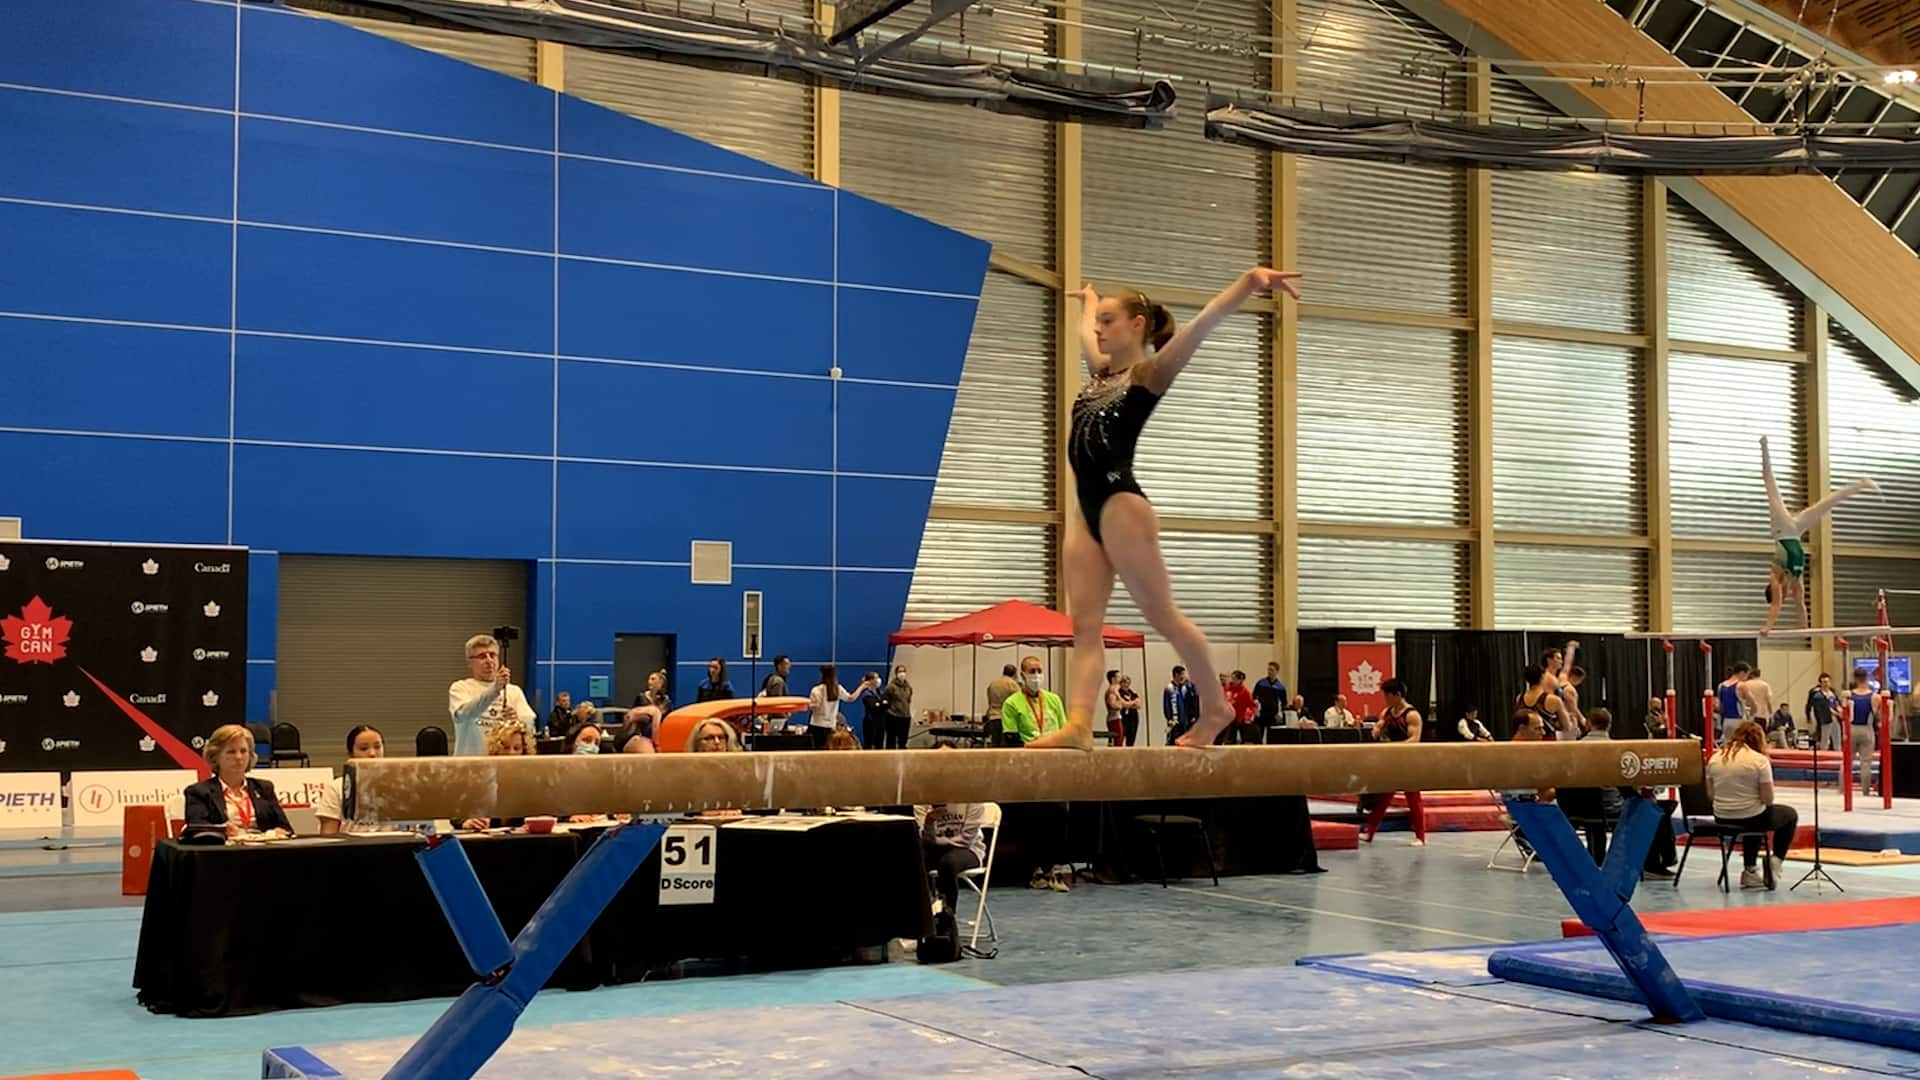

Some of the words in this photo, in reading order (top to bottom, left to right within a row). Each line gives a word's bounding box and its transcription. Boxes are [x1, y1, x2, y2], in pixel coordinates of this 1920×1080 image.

[20, 623, 53, 640] GYM
[20, 640, 52, 654] CAN
[1640, 757, 1679, 769] SPIETH
[661, 878, 671, 890] D
[673, 878, 713, 890] Score
